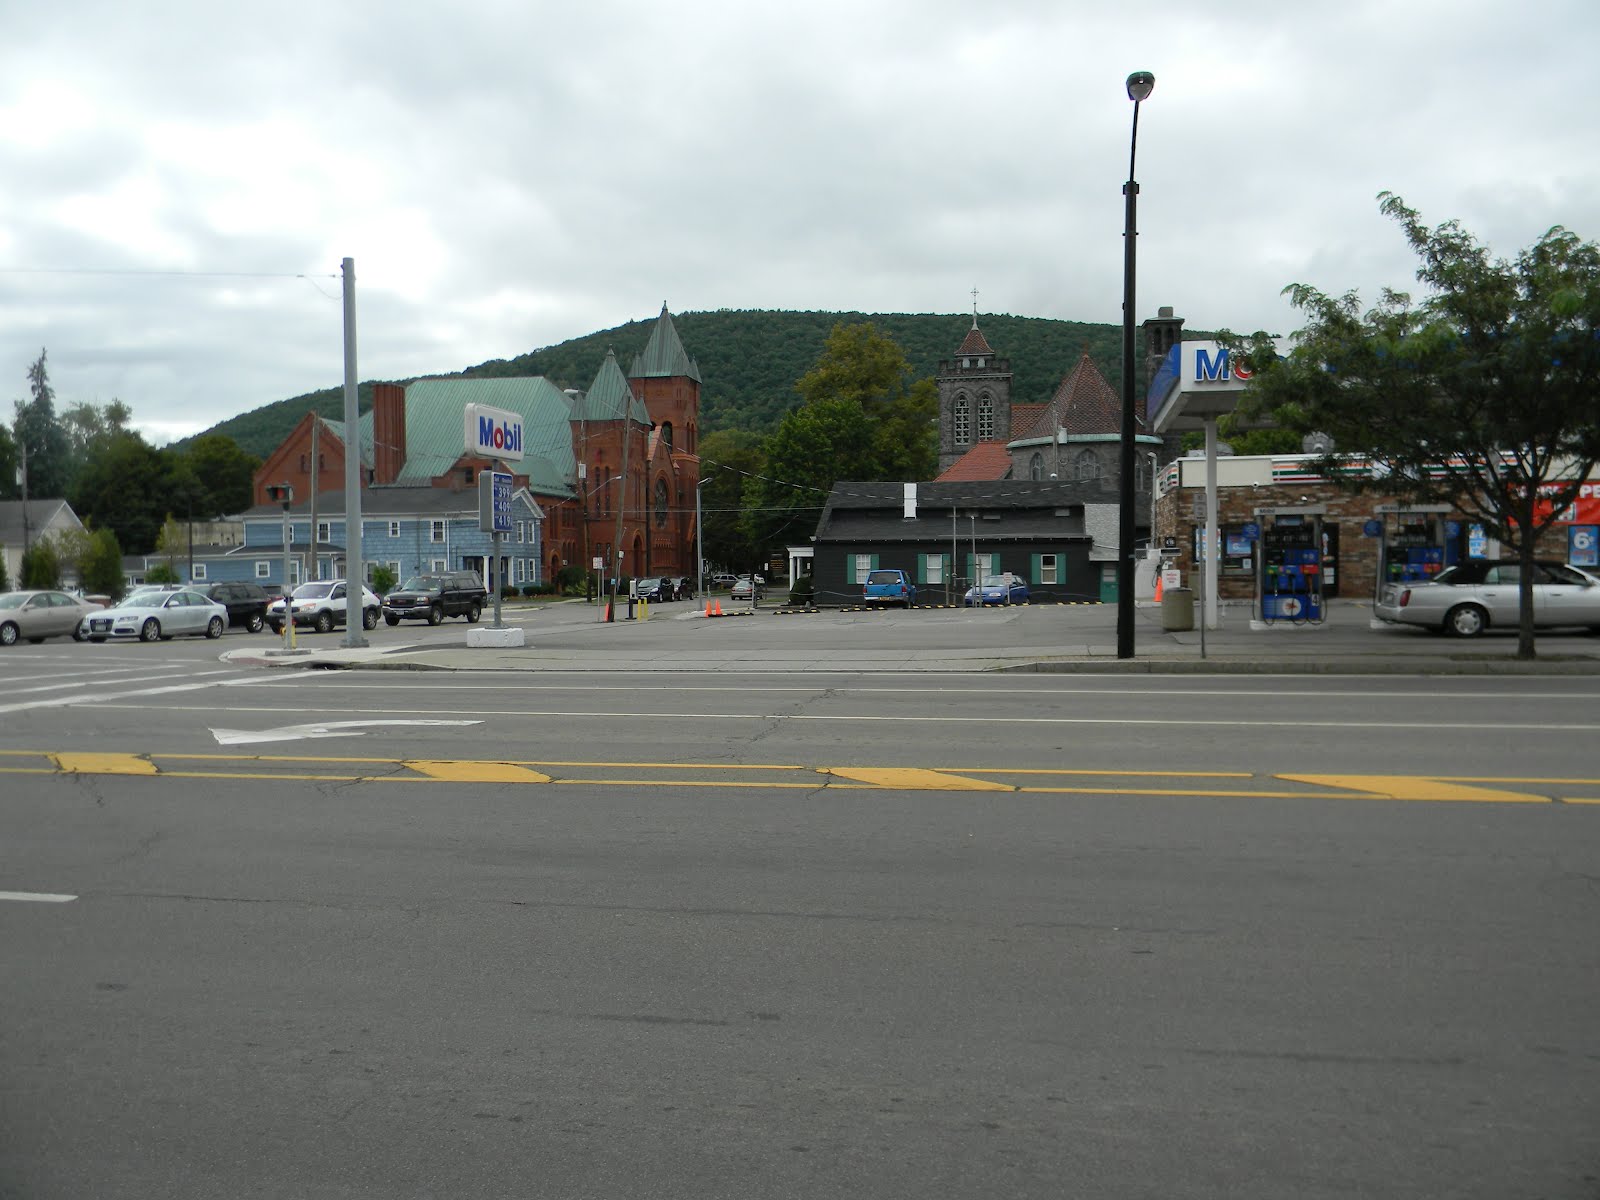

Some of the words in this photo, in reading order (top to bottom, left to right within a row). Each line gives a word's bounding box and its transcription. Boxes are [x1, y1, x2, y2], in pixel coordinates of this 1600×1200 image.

[479, 416, 522, 452] Mobil
[498, 487, 511, 499] 399
[498, 501, 511, 513] 409
[498, 515, 511, 528] 419
